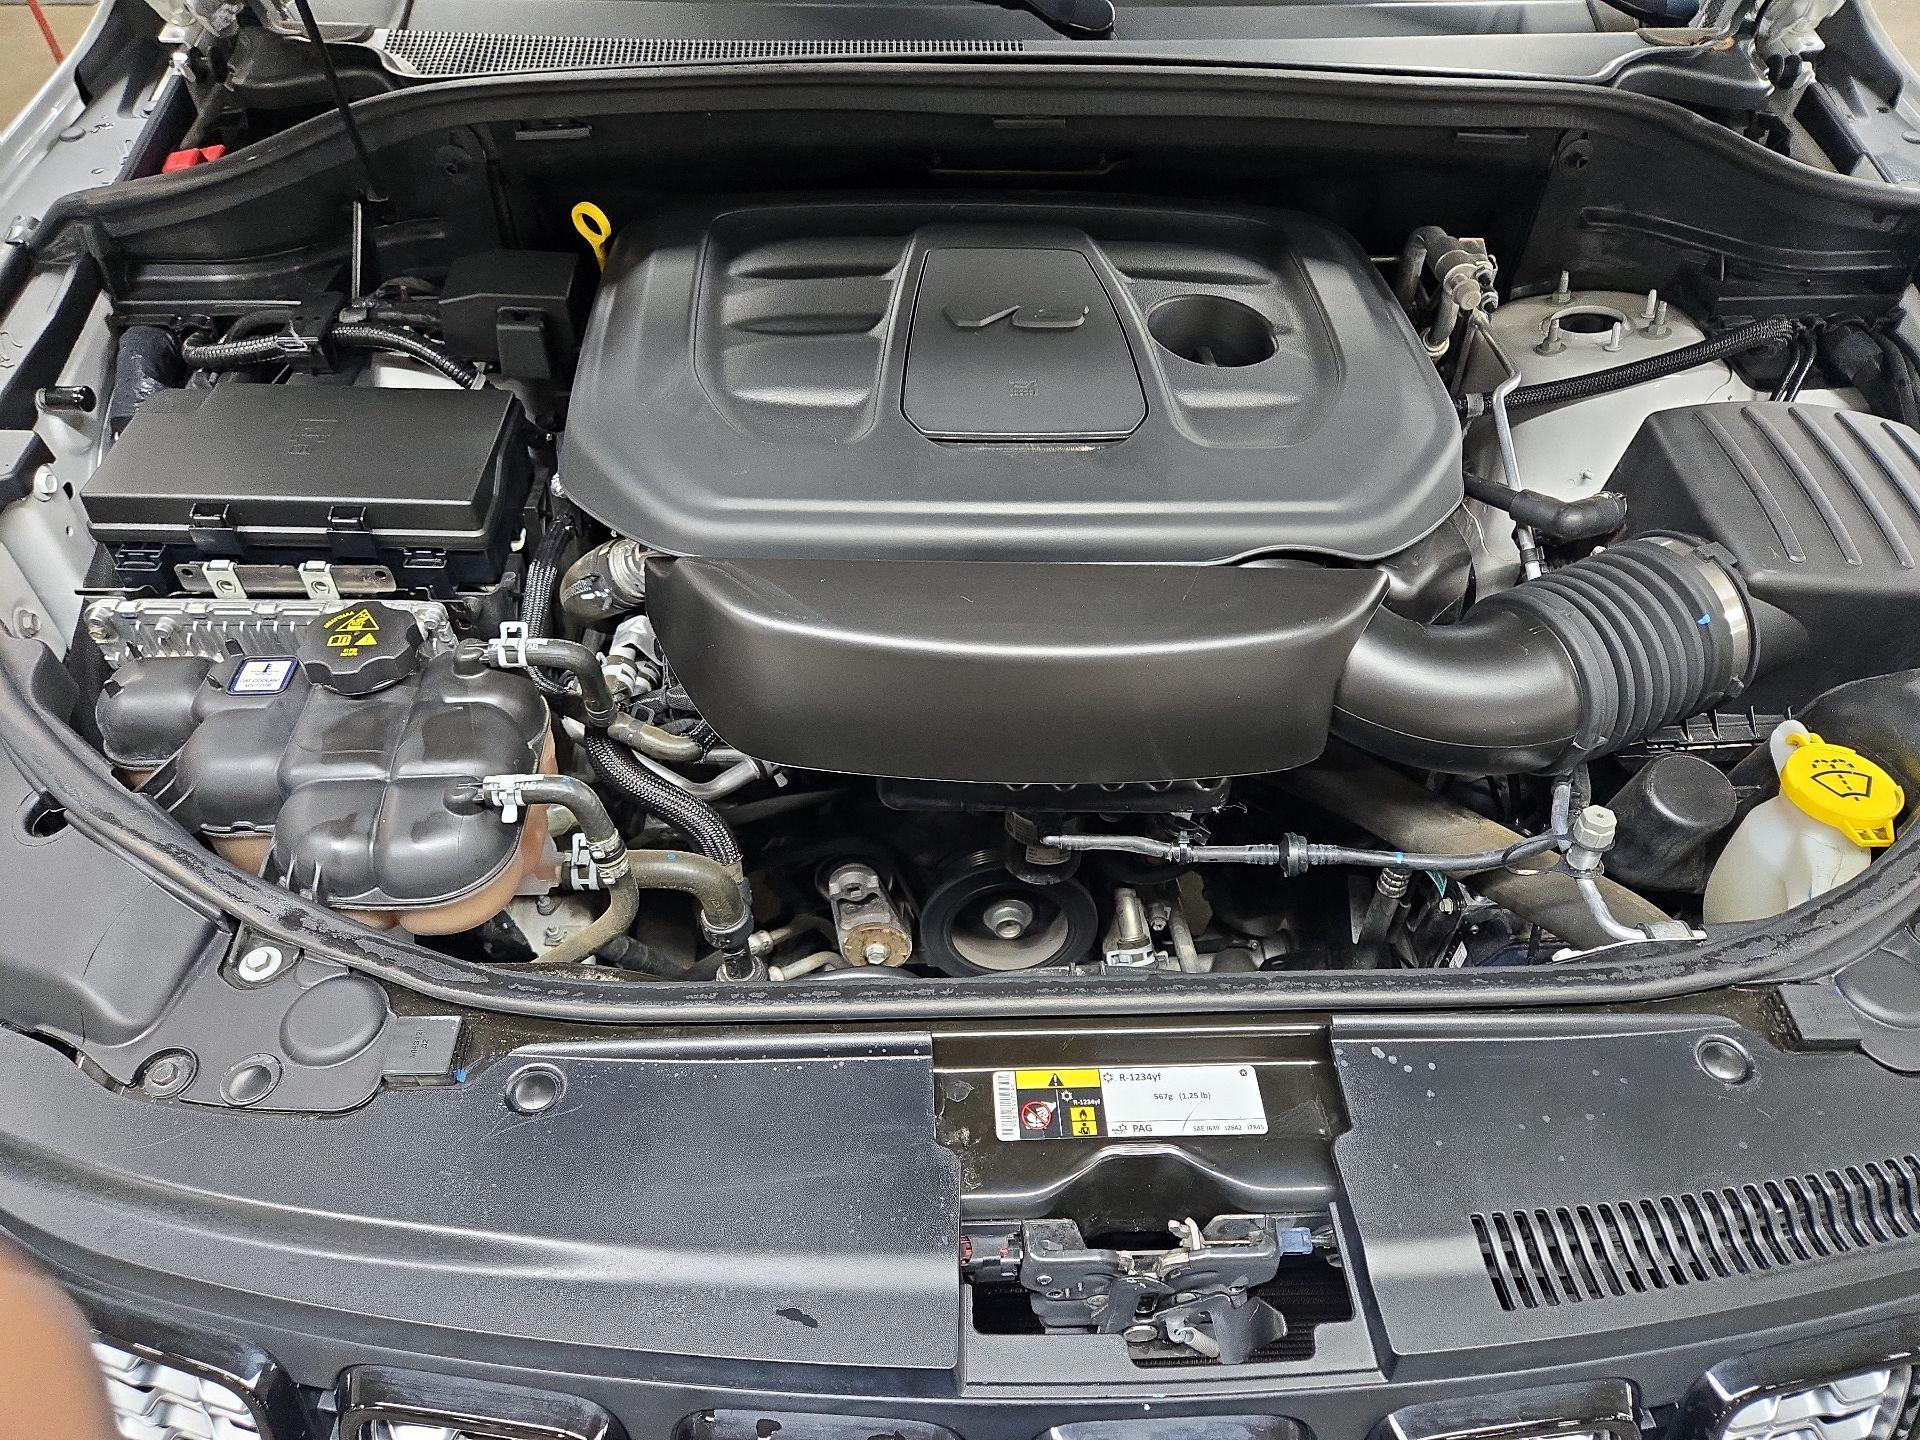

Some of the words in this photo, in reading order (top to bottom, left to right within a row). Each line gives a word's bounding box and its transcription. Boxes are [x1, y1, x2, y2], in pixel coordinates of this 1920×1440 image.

[1119, 1072, 1162, 1082] R-1234yf
[1153, 1093, 1173, 1101] 567g
[1178, 1092, 1199, 1101] (1.25
[1200, 1091, 1211, 1100] lb)
[1072, 1098, 1100, 1106] R-1234yf
[1132, 1124, 1153, 1133] PAG
